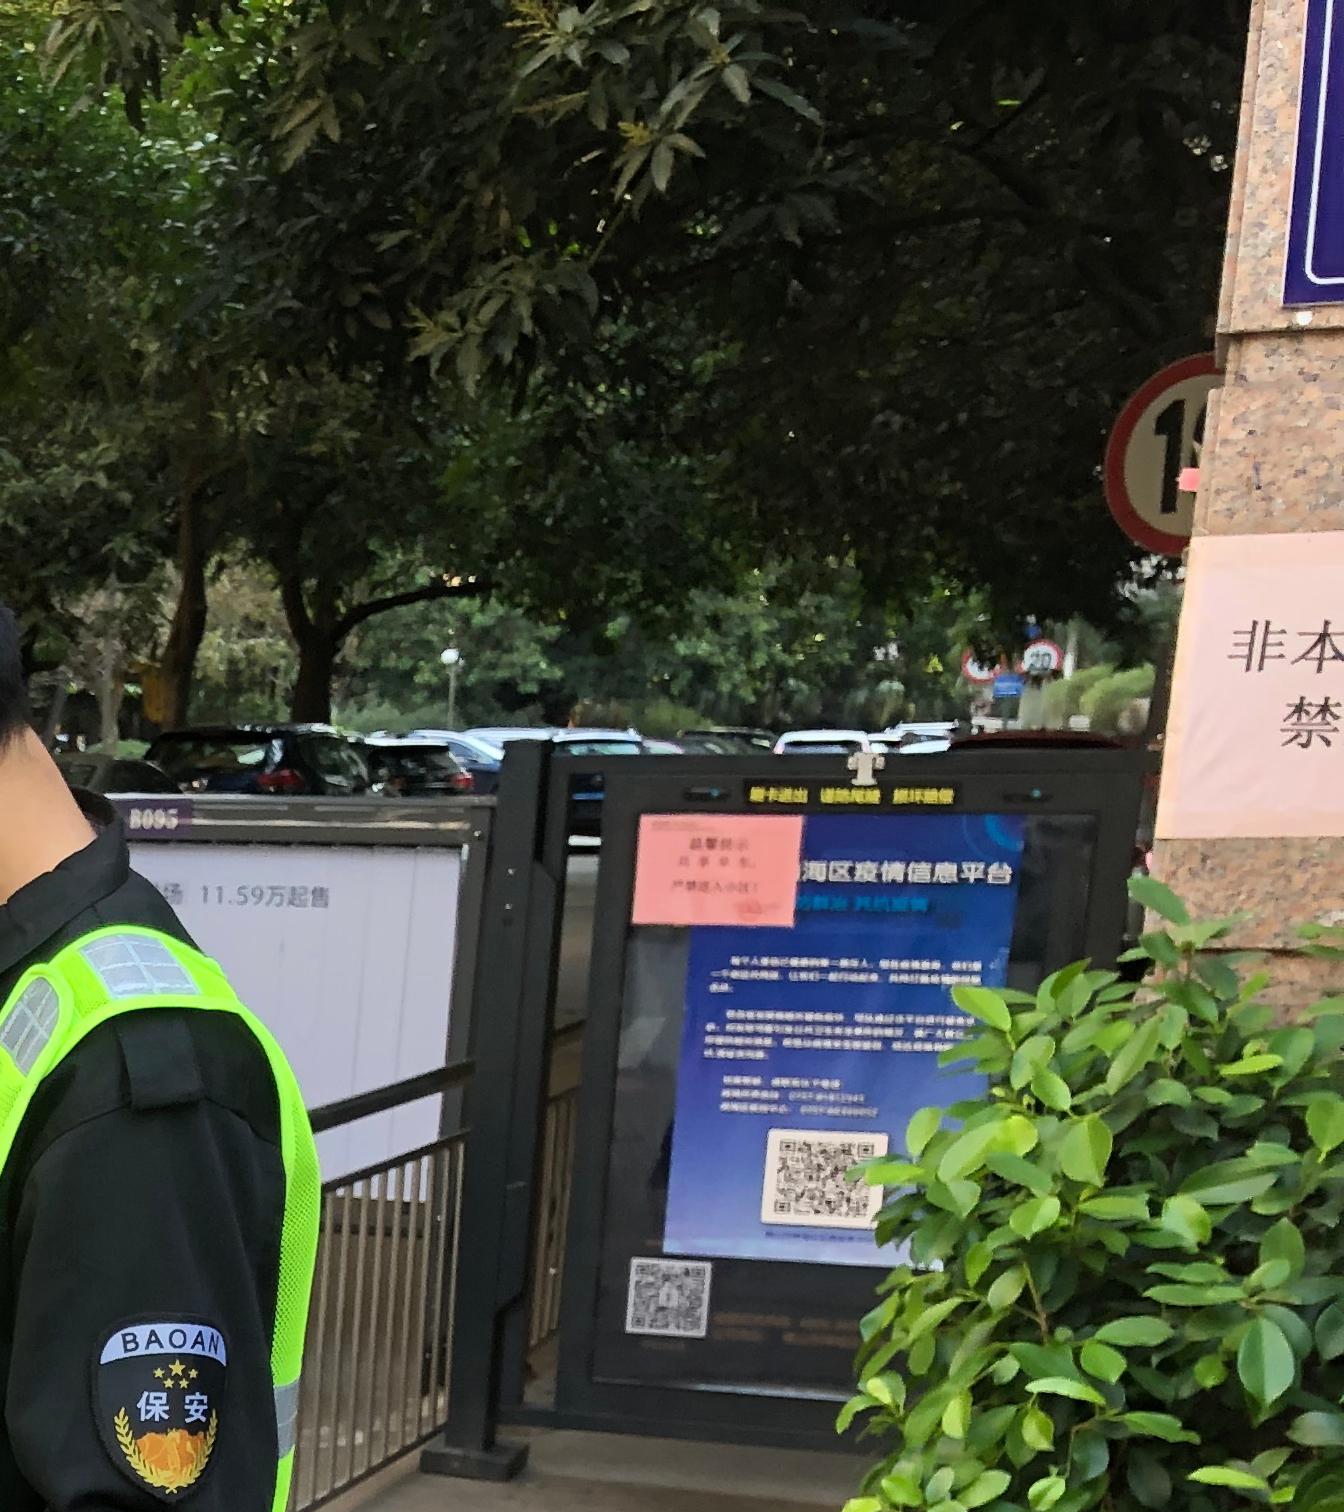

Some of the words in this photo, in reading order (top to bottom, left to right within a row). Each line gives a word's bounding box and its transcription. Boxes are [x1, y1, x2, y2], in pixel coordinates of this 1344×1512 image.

[1280, 696, 1343, 749] 禁
[200, 884, 330, 909] 11.59万起售
[121, 1328, 220, 1356] BAOAN
[136, 1391, 209, 1424] 保安
